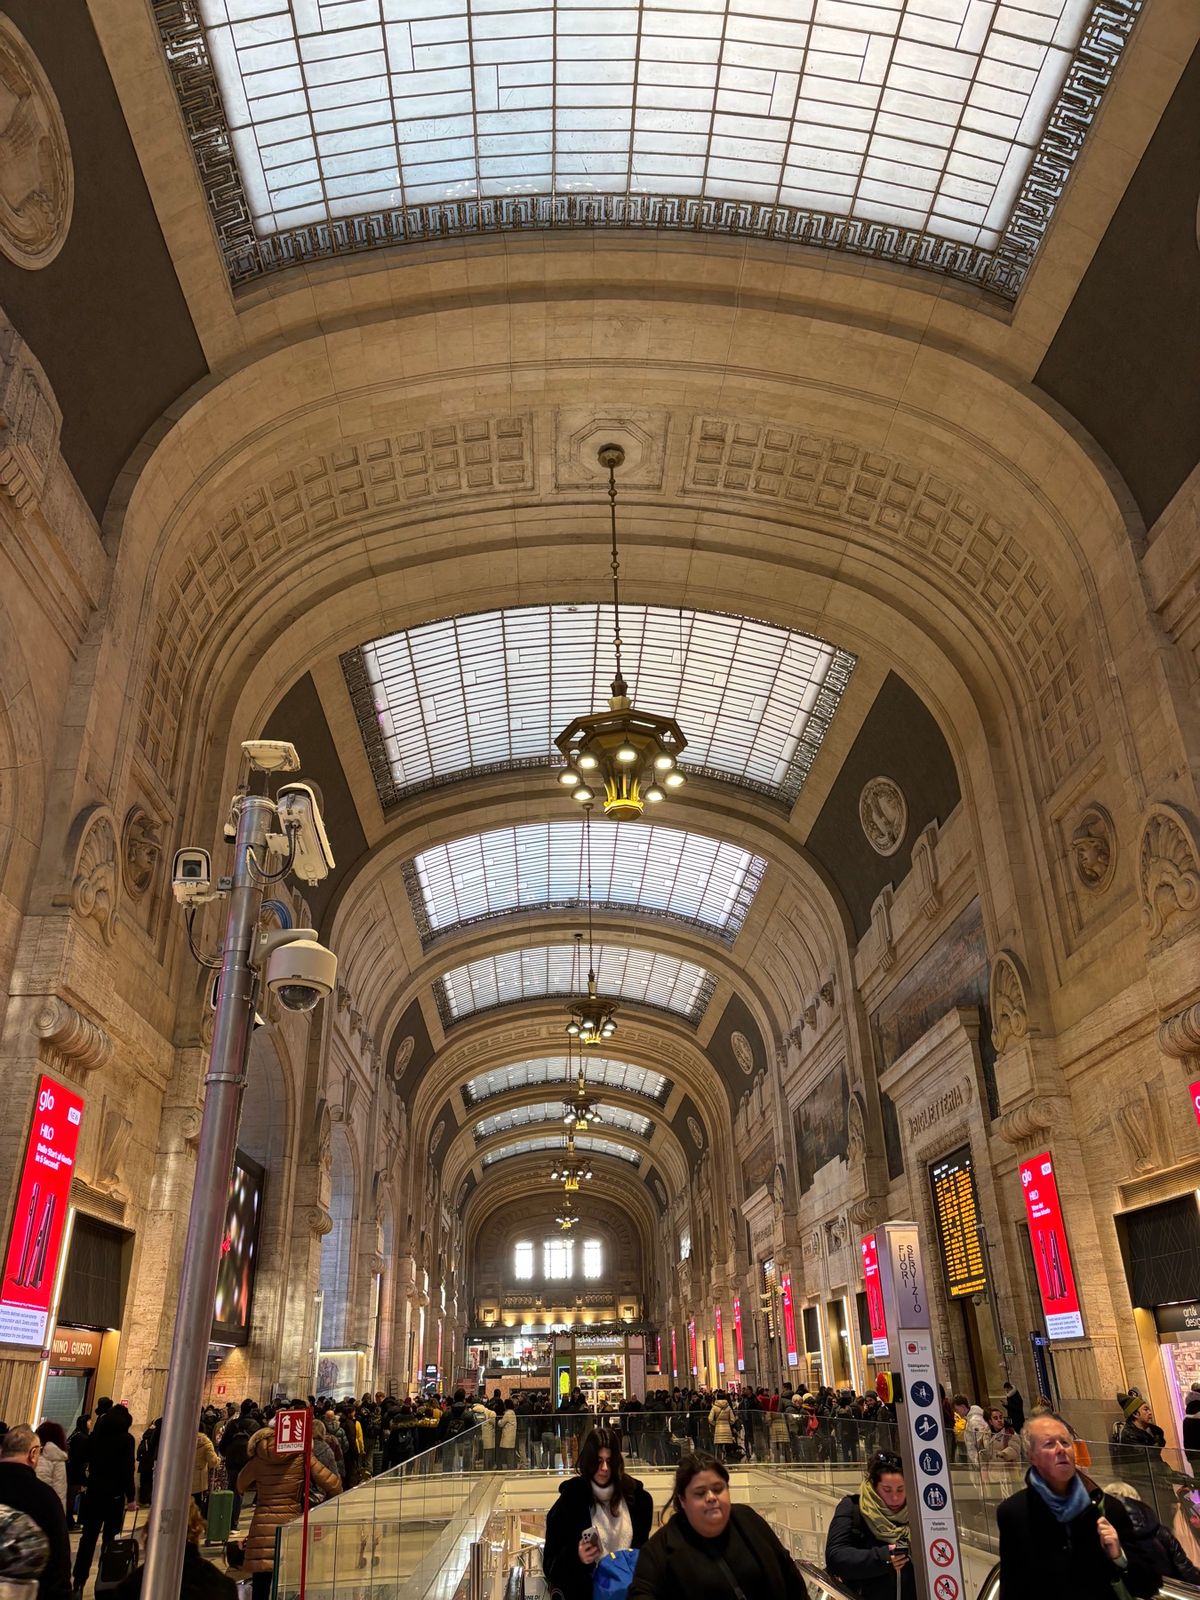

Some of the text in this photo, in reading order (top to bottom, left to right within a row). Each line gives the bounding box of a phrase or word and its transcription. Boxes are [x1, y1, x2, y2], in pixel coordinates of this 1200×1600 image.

[39, 1089, 54, 1111] glo
[913, 1085, 963, 1136] BIGLIETTERIA
[1022, 1169, 1032, 1187] glo
[899, 1245, 908, 1288] FUORI
[907, 1245, 921, 1313] SERVIZIO
[71, 1342, 92, 1355] GIUSTO
